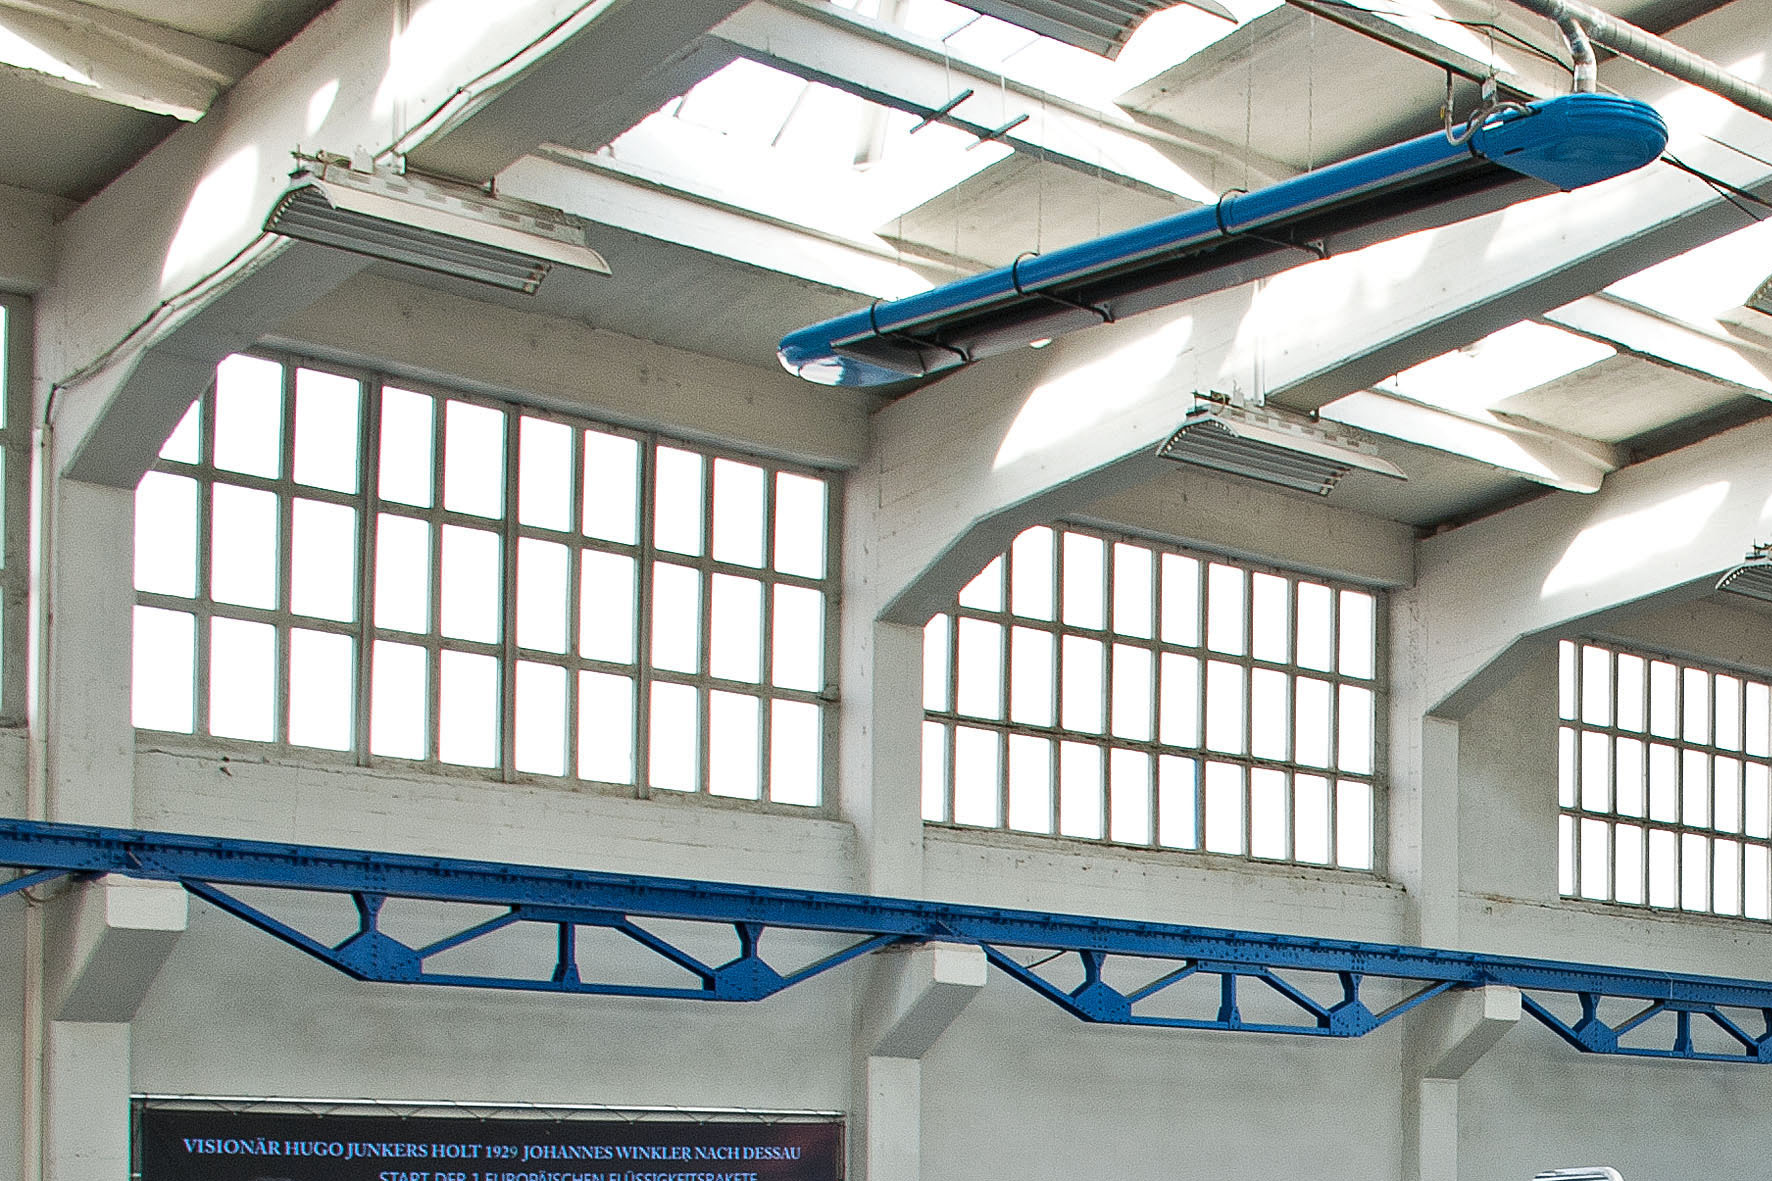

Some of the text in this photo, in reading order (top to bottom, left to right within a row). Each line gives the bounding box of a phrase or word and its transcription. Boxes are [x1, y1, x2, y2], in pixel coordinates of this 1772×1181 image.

[183, 1137, 800, 1162] VISIONÄR HUGO JUNKERS HOLT 1929 JOHANNES WINKLER NACH DESSAU
